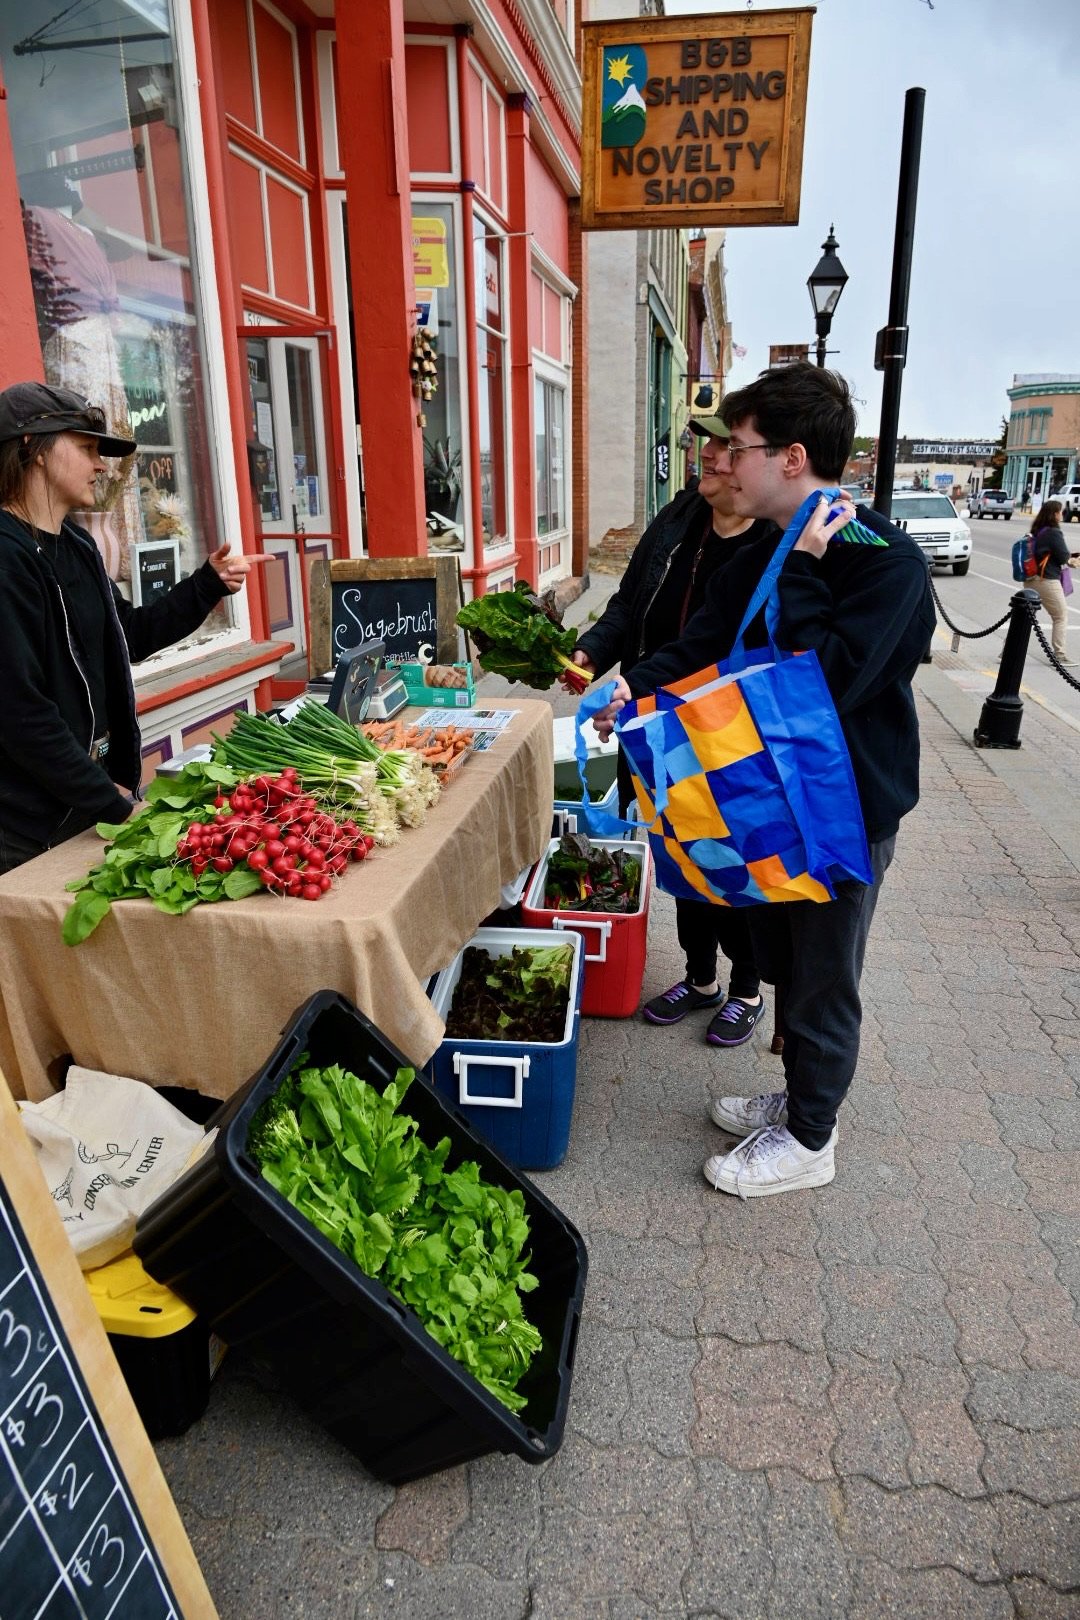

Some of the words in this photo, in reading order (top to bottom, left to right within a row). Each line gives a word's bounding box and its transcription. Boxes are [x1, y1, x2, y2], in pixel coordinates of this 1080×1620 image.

[681, 36, 752, 69] B&B
[645, 70, 786, 107] SHIPPING
[676, 107, 749, 140] AND
[612, 141, 771, 177] NOVELTY
[644, 176, 735, 206] SHOP
[128, 402, 165, 439] pen
[657, 445, 668, 479] OPEN
[966, 446, 991, 454] SALOON
[335, 588, 438, 652] Sagebrush
[136, 1136, 164, 1174] CENTER
[7, 1382, 64, 1448] $3
[72, 1523, 125, 1589] $3
